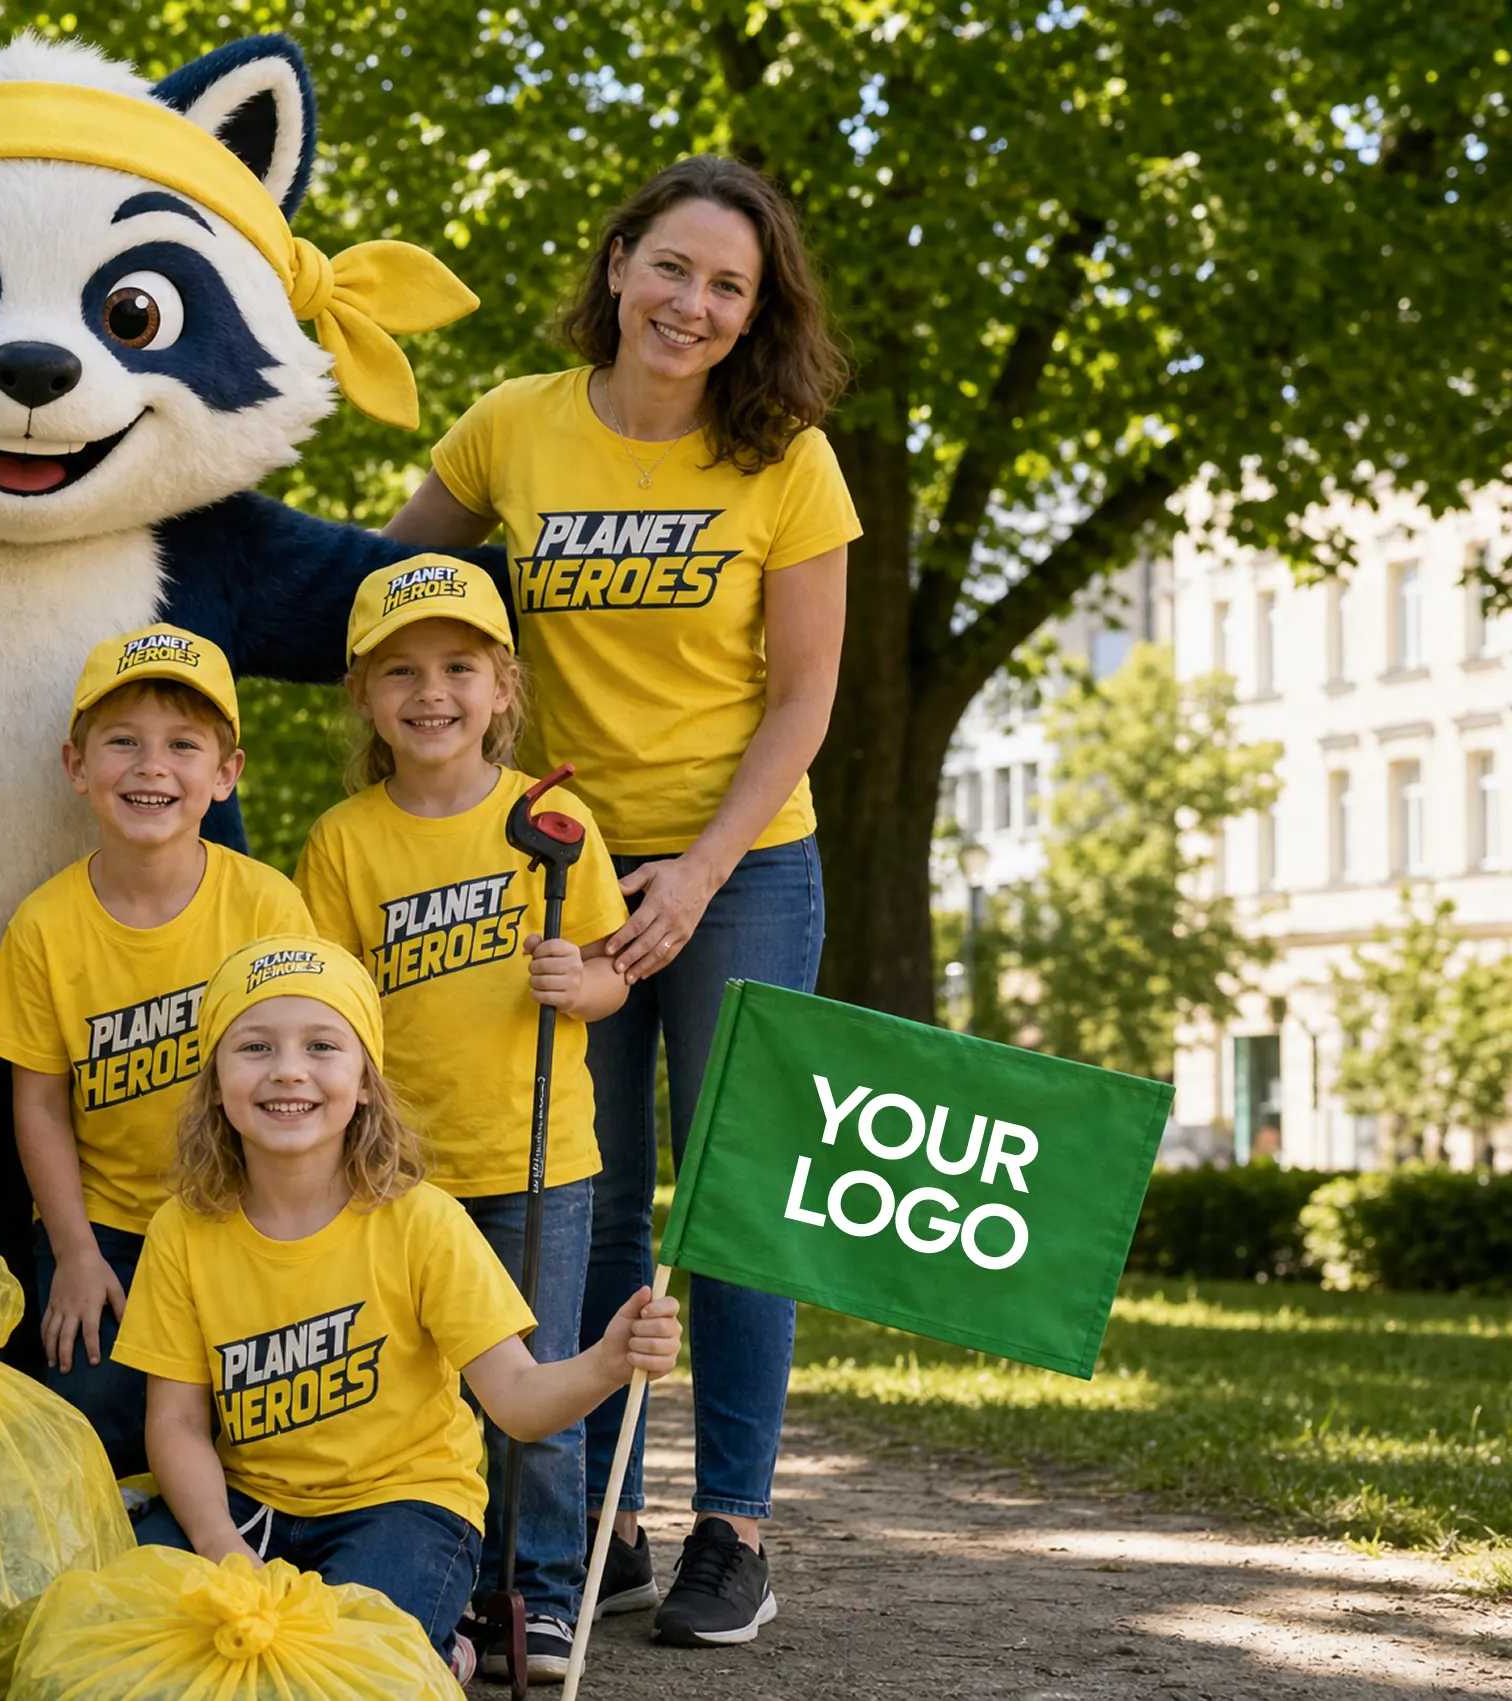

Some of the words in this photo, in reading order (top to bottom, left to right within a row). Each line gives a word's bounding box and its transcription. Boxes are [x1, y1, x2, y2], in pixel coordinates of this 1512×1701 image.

[536, 513, 712, 557] PLANET
[383, 580, 466, 614] HEROES
[389, 567, 456, 594] PLANET
[518, 555, 726, 611] HEROES
[125, 635, 191, 656] PLANET
[386, 876, 509, 943] PLANET
[252, 951, 316, 973] PLANET
[374, 909, 522, 993] HEROES
[91, 985, 207, 1059] PLANET
[78, 1030, 200, 1108] HEROE
[813, 1074, 1039, 1194] YOUR
[784, 1155, 1029, 1270] LOGO
[222, 1309, 355, 1390] PLANET
[218, 1344, 379, 1443] HEROES
